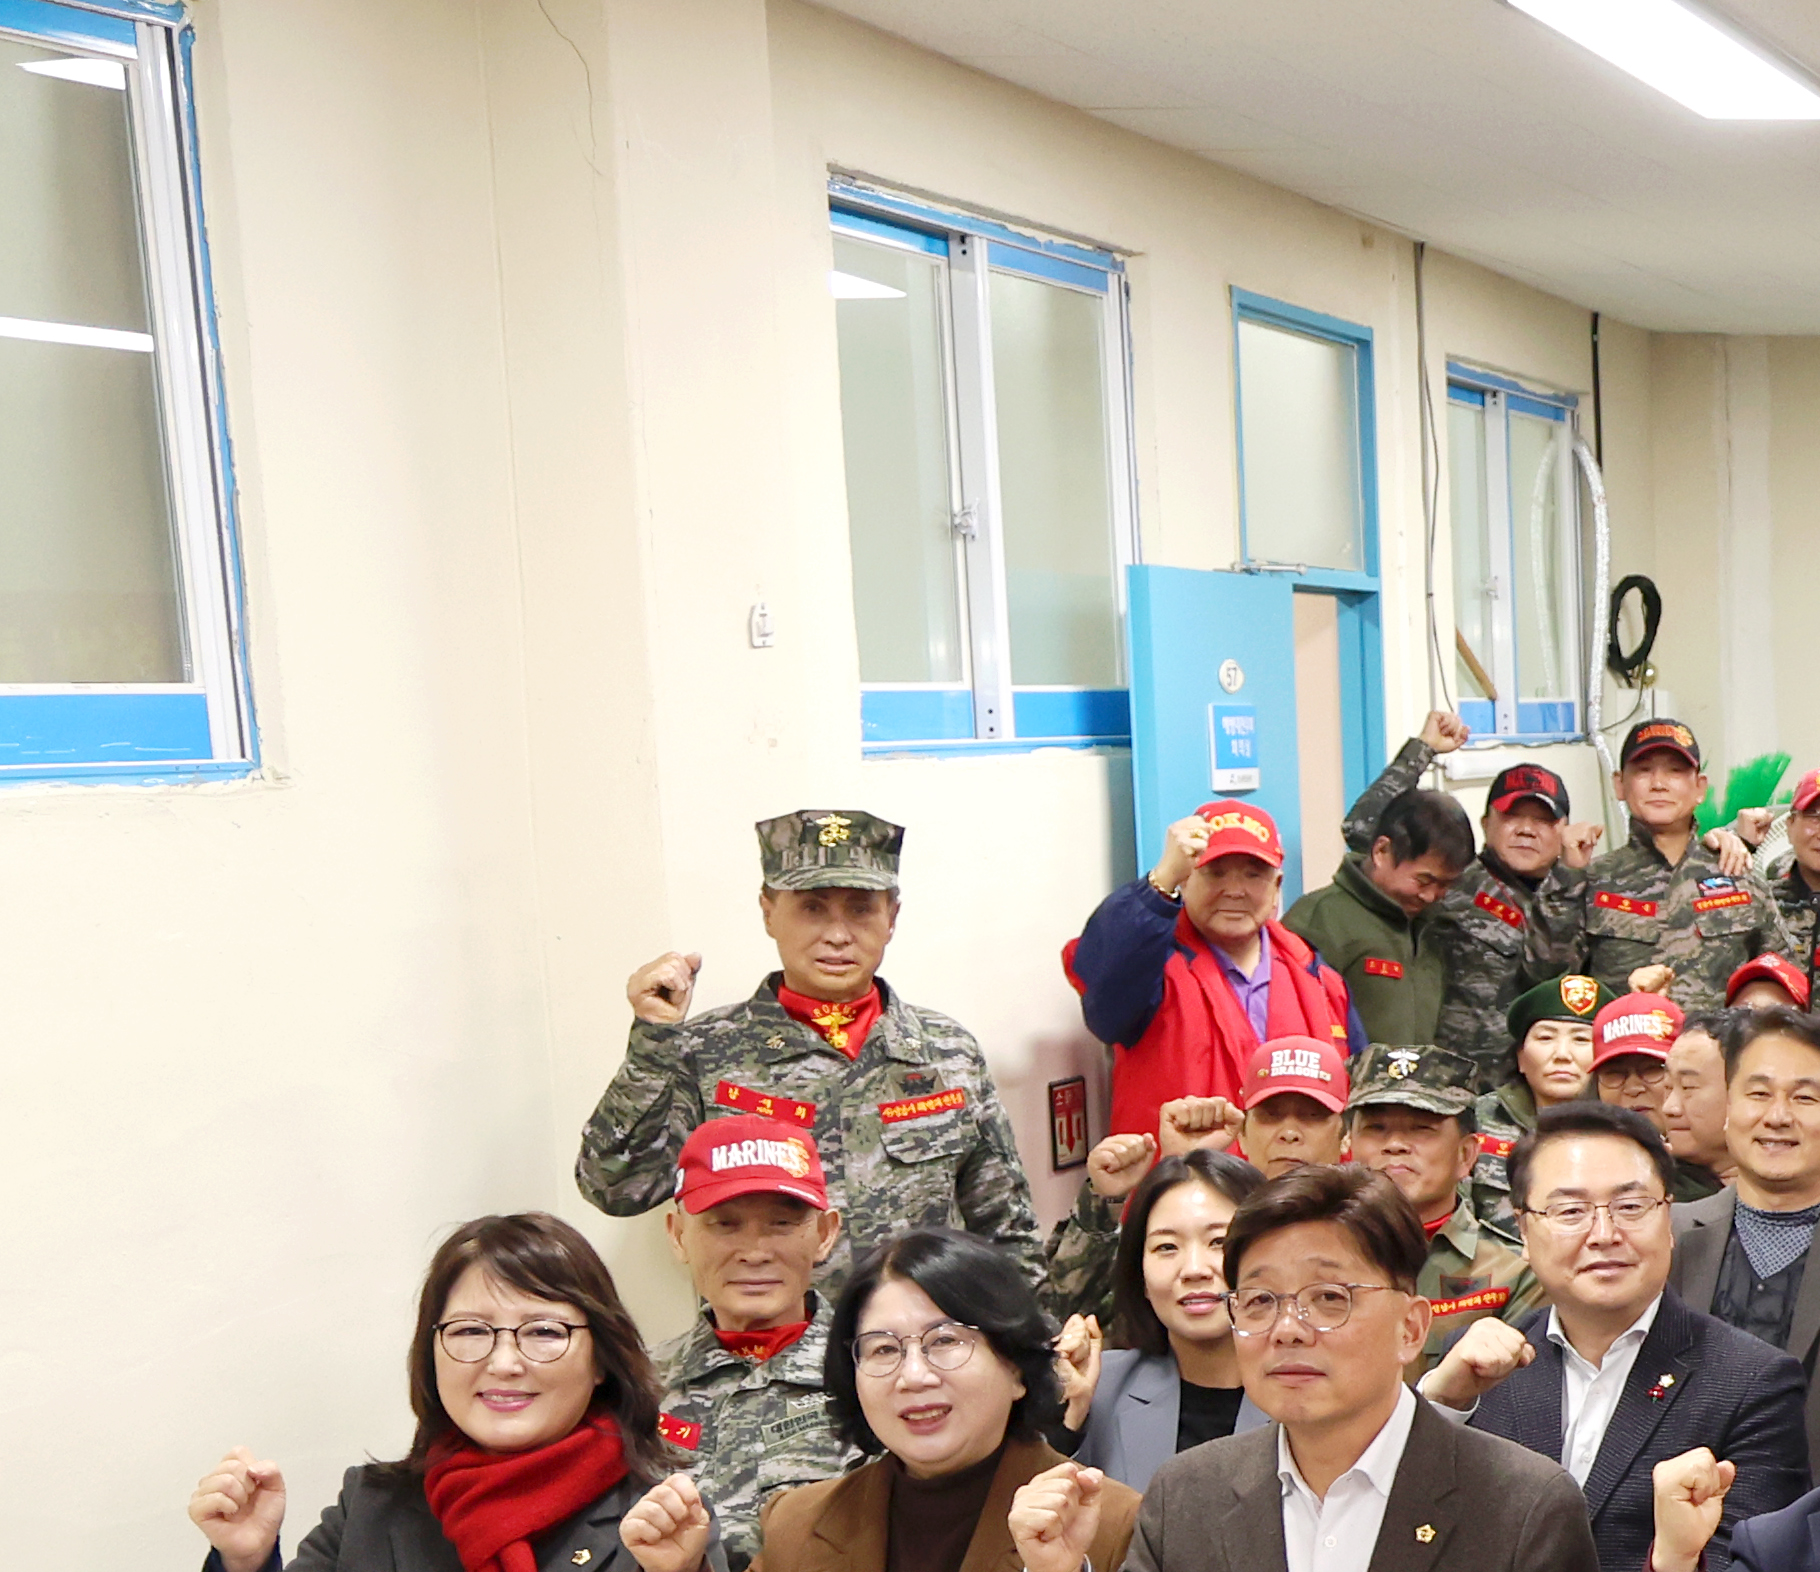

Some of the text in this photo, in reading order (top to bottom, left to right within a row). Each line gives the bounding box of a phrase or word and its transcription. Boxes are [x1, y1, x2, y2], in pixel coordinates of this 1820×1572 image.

[1225, 666, 1238, 688] 57
[1603, 1013, 1662, 1044] MARINES
[1271, 1049, 1321, 1070] BLUE
[1270, 1065, 1319, 1079] DRAGON
[711, 1138, 802, 1173] MARINES
